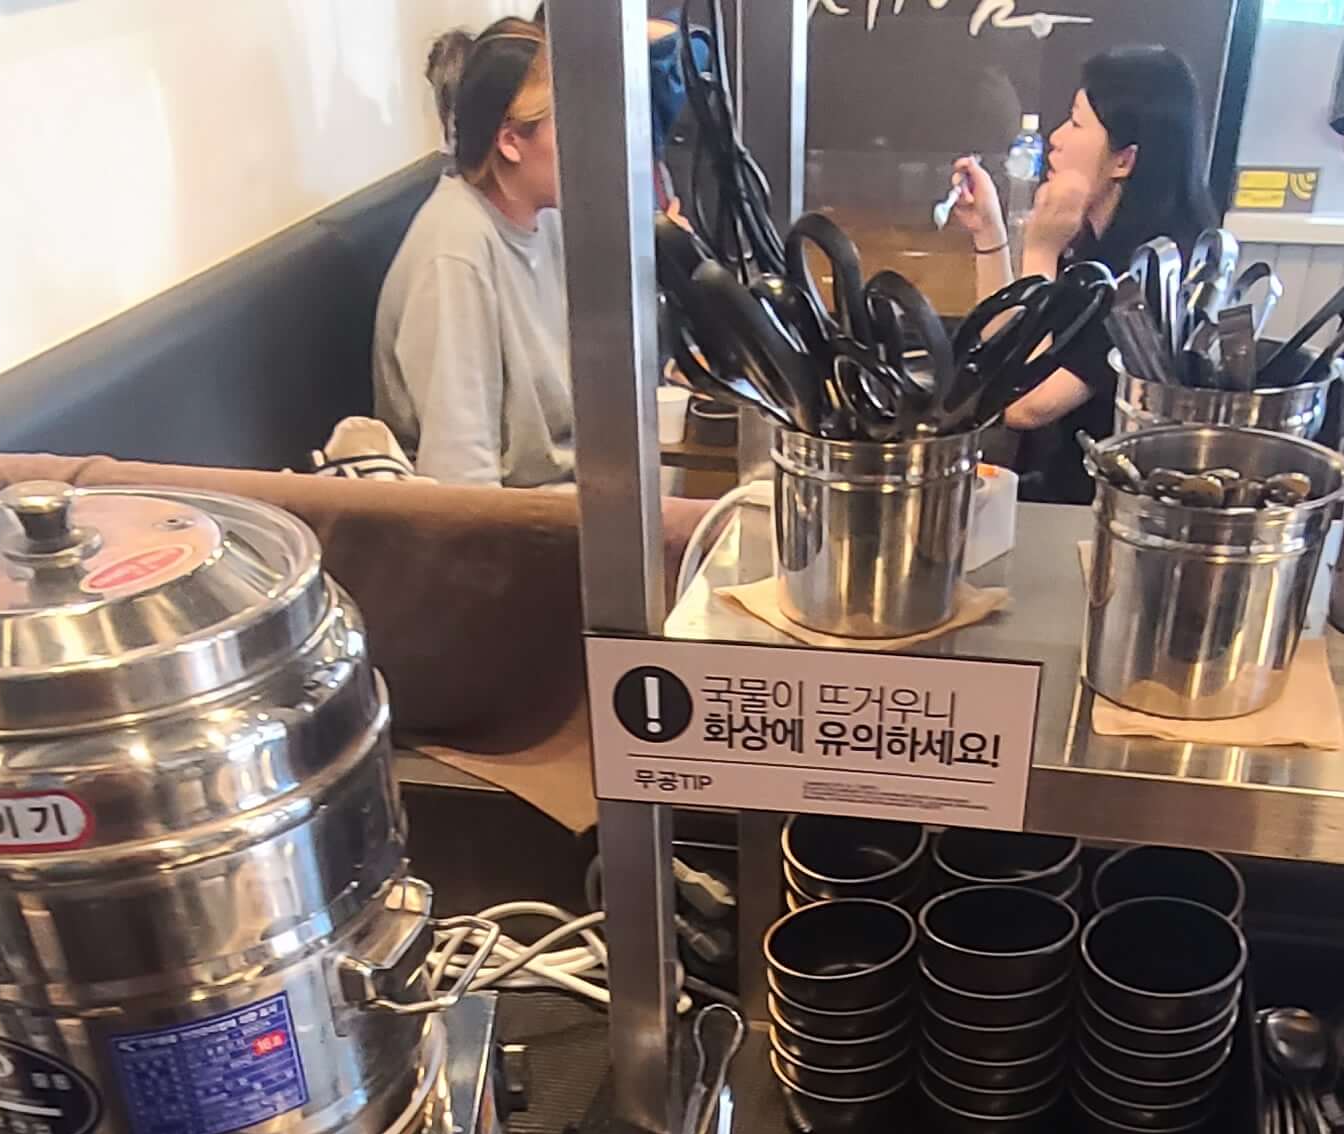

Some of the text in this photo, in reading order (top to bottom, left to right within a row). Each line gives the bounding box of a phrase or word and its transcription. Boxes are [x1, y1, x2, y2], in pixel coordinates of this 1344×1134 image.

[700, 675, 956, 726] 국물이 뜨거우니
[703, 713, 1001, 767] 화상에 유의하세요!
[633, 768, 713, 792] 무공TIP
